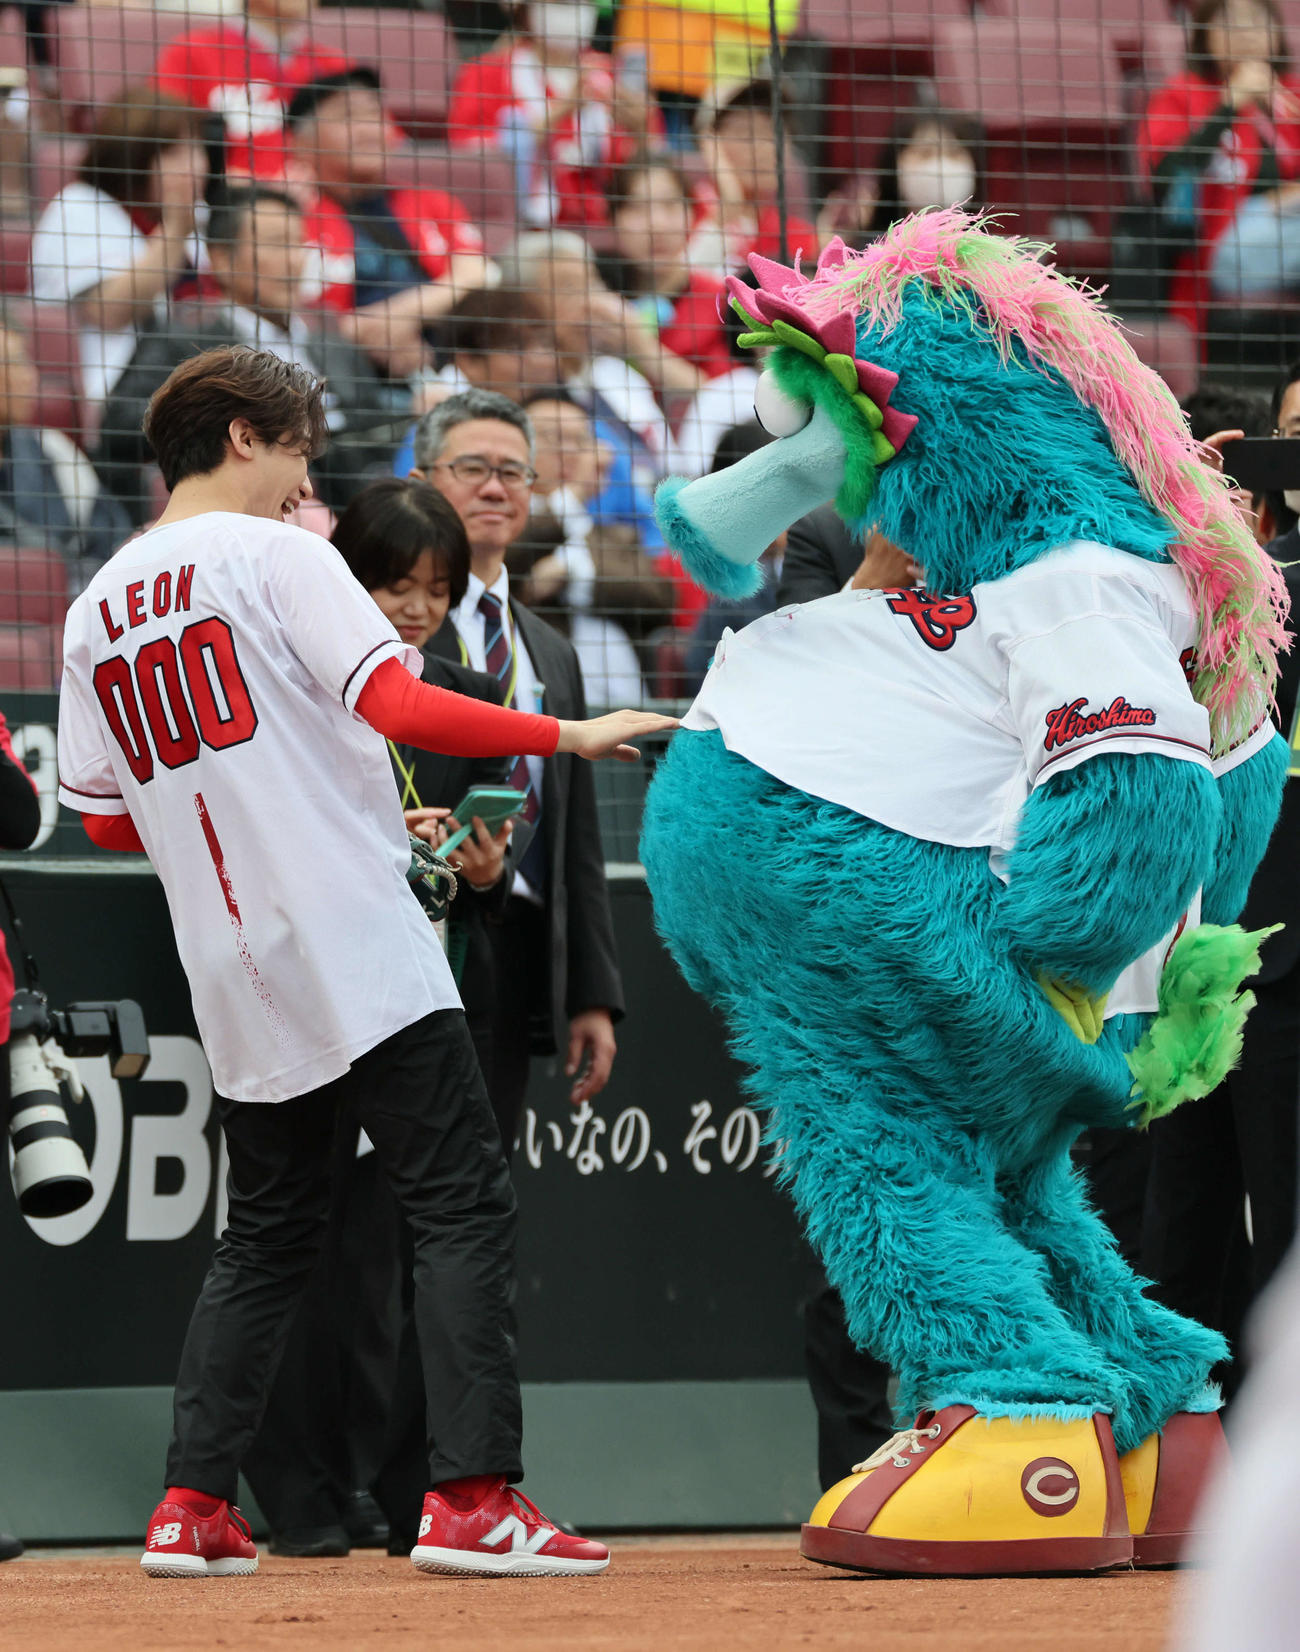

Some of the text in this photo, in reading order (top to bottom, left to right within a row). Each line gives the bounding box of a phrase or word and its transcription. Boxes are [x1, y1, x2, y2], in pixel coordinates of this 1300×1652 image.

[99, 564, 195, 644] LEON
[93, 615, 259, 785] 000
[1044, 696, 1157, 751] Hiroshima
[1025, 1466, 1078, 1506] C
